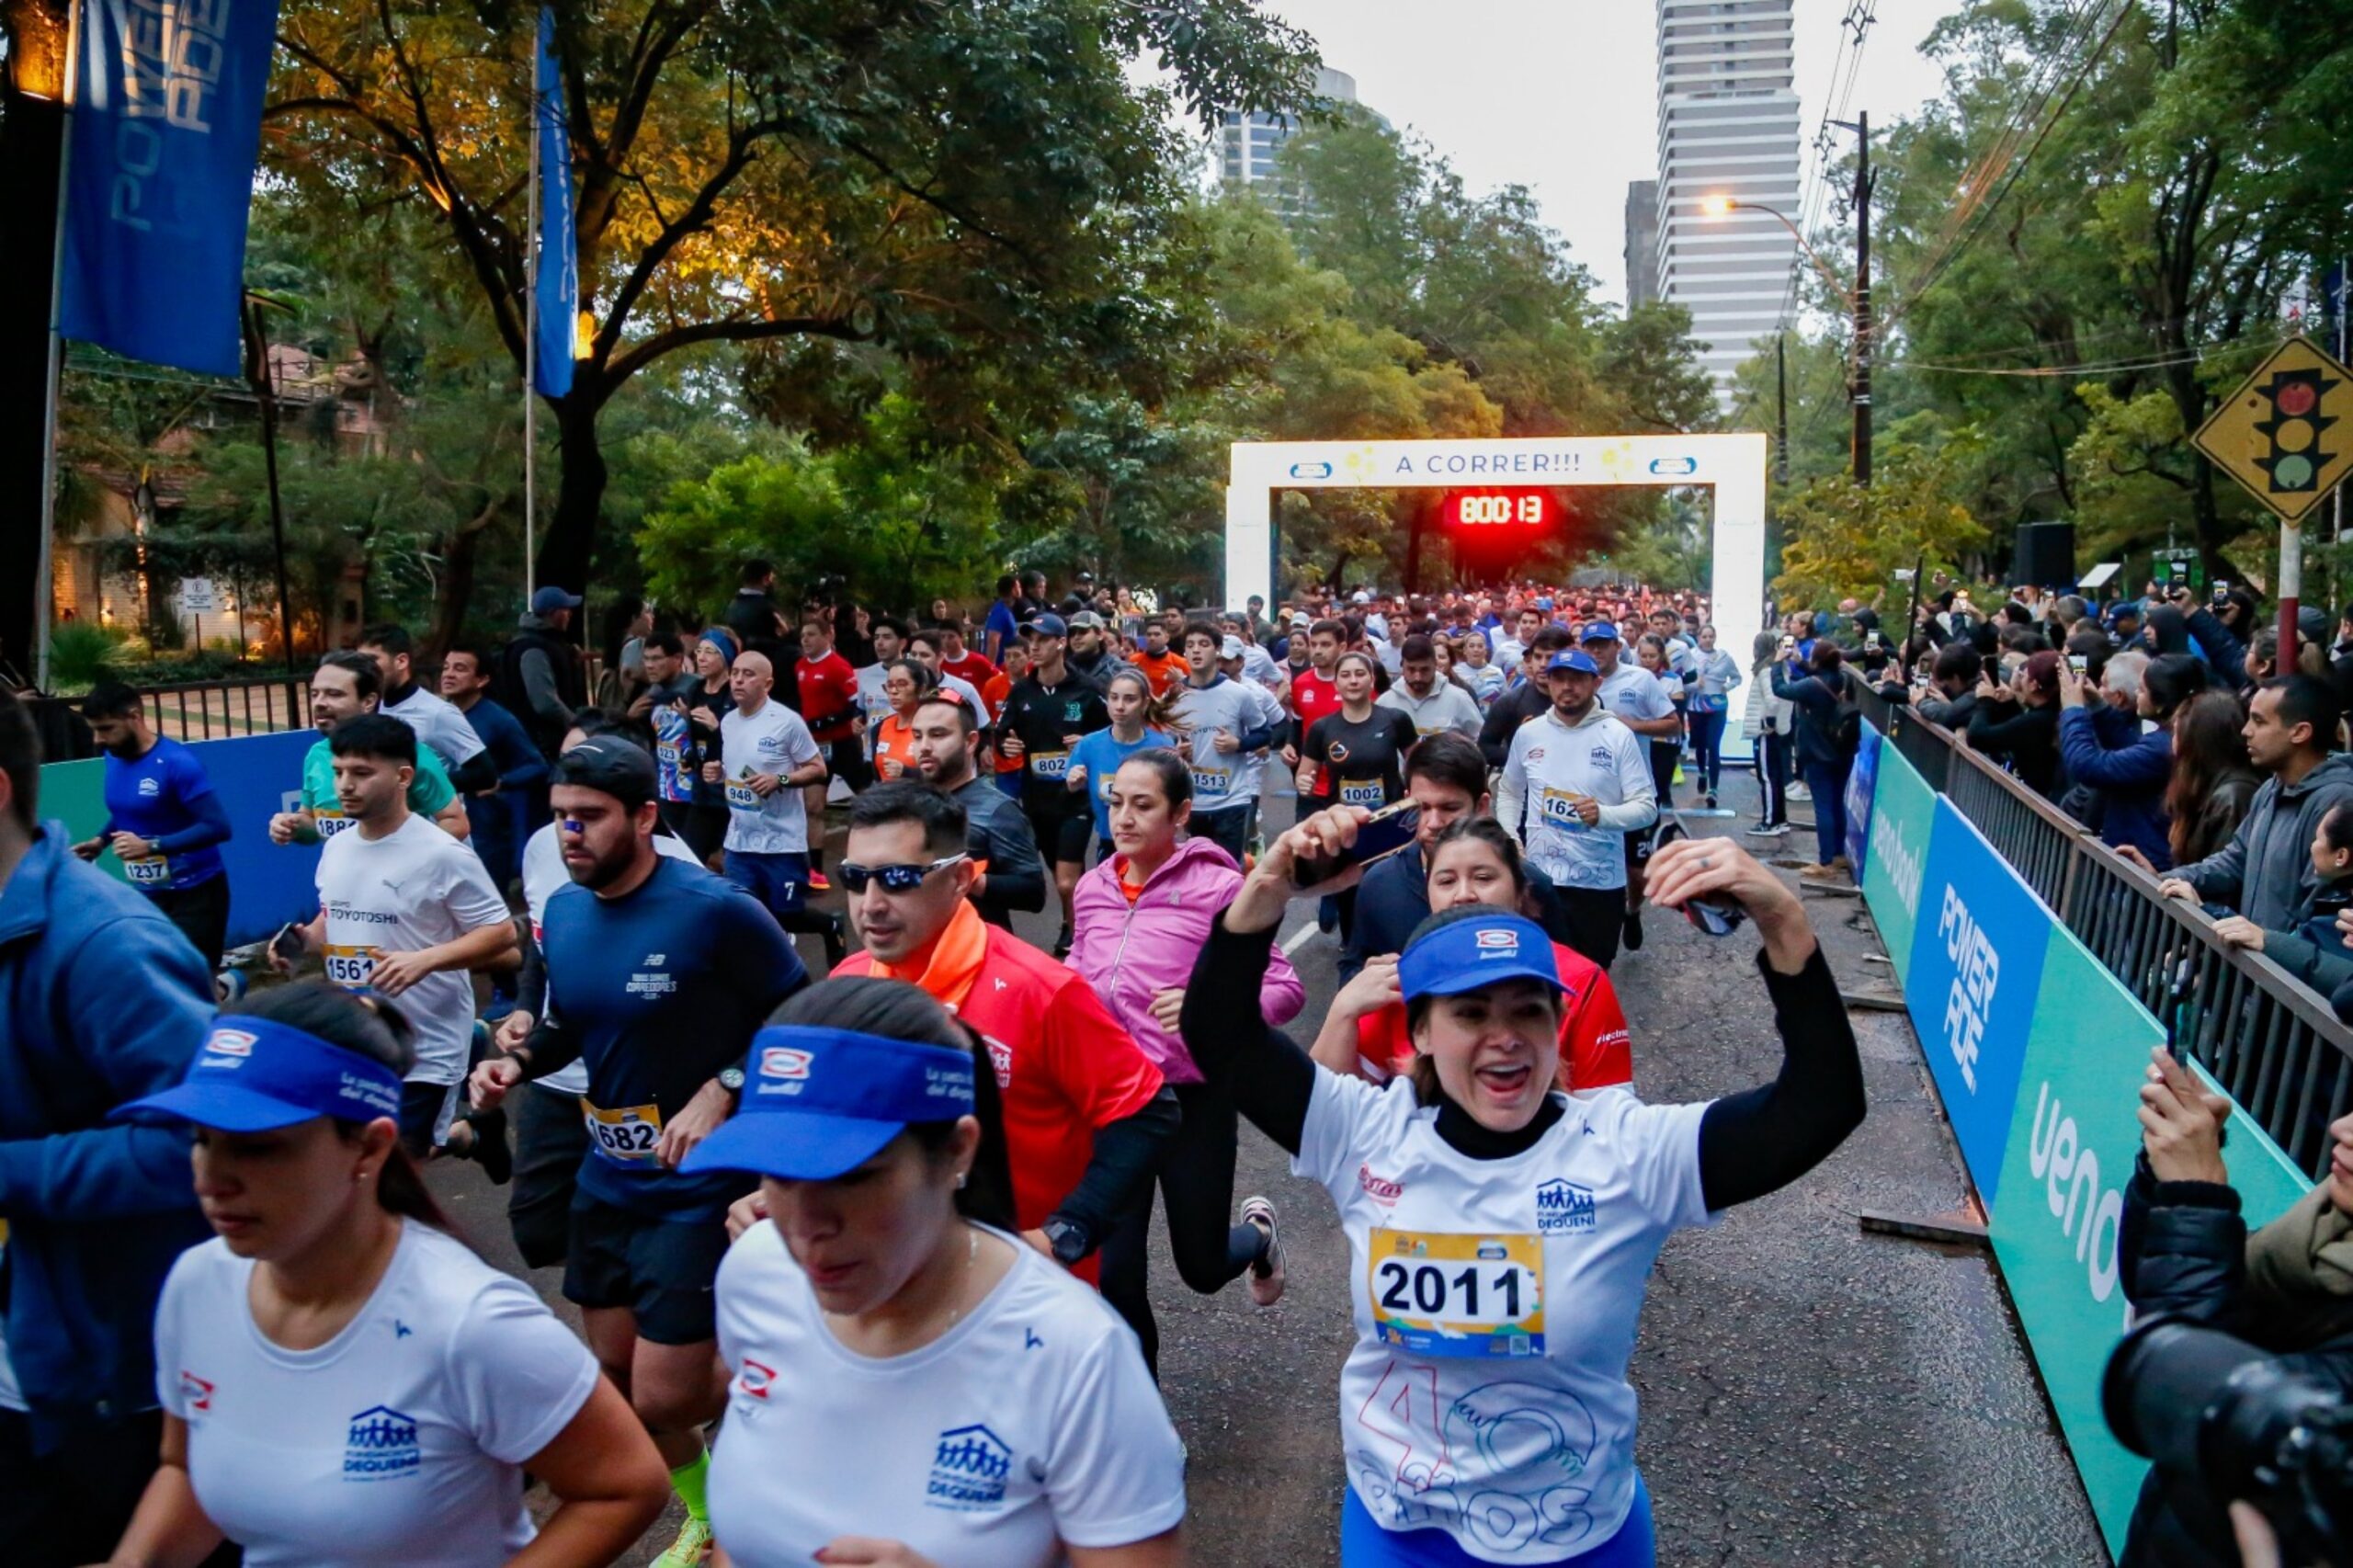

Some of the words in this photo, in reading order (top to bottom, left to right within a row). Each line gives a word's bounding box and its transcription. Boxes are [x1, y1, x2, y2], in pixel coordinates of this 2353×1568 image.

[109, 0, 175, 233] POWE
[1396, 456, 1414, 473] A
[1427, 453, 1579, 473] CORRER!!!
[1039, 758, 1066, 772] 802
[1194, 773, 1227, 788] 1513
[729, 788, 753, 802] 948
[1344, 788, 1381, 801] 1002
[128, 864, 164, 879] 1237
[784, 881, 795, 901] 7
[330, 907, 398, 925] TOYOTOSHI
[1938, 882, 2000, 1024] POWER
[589, 1117, 654, 1151] 1682
[1381, 1262, 1520, 1318] 2011
